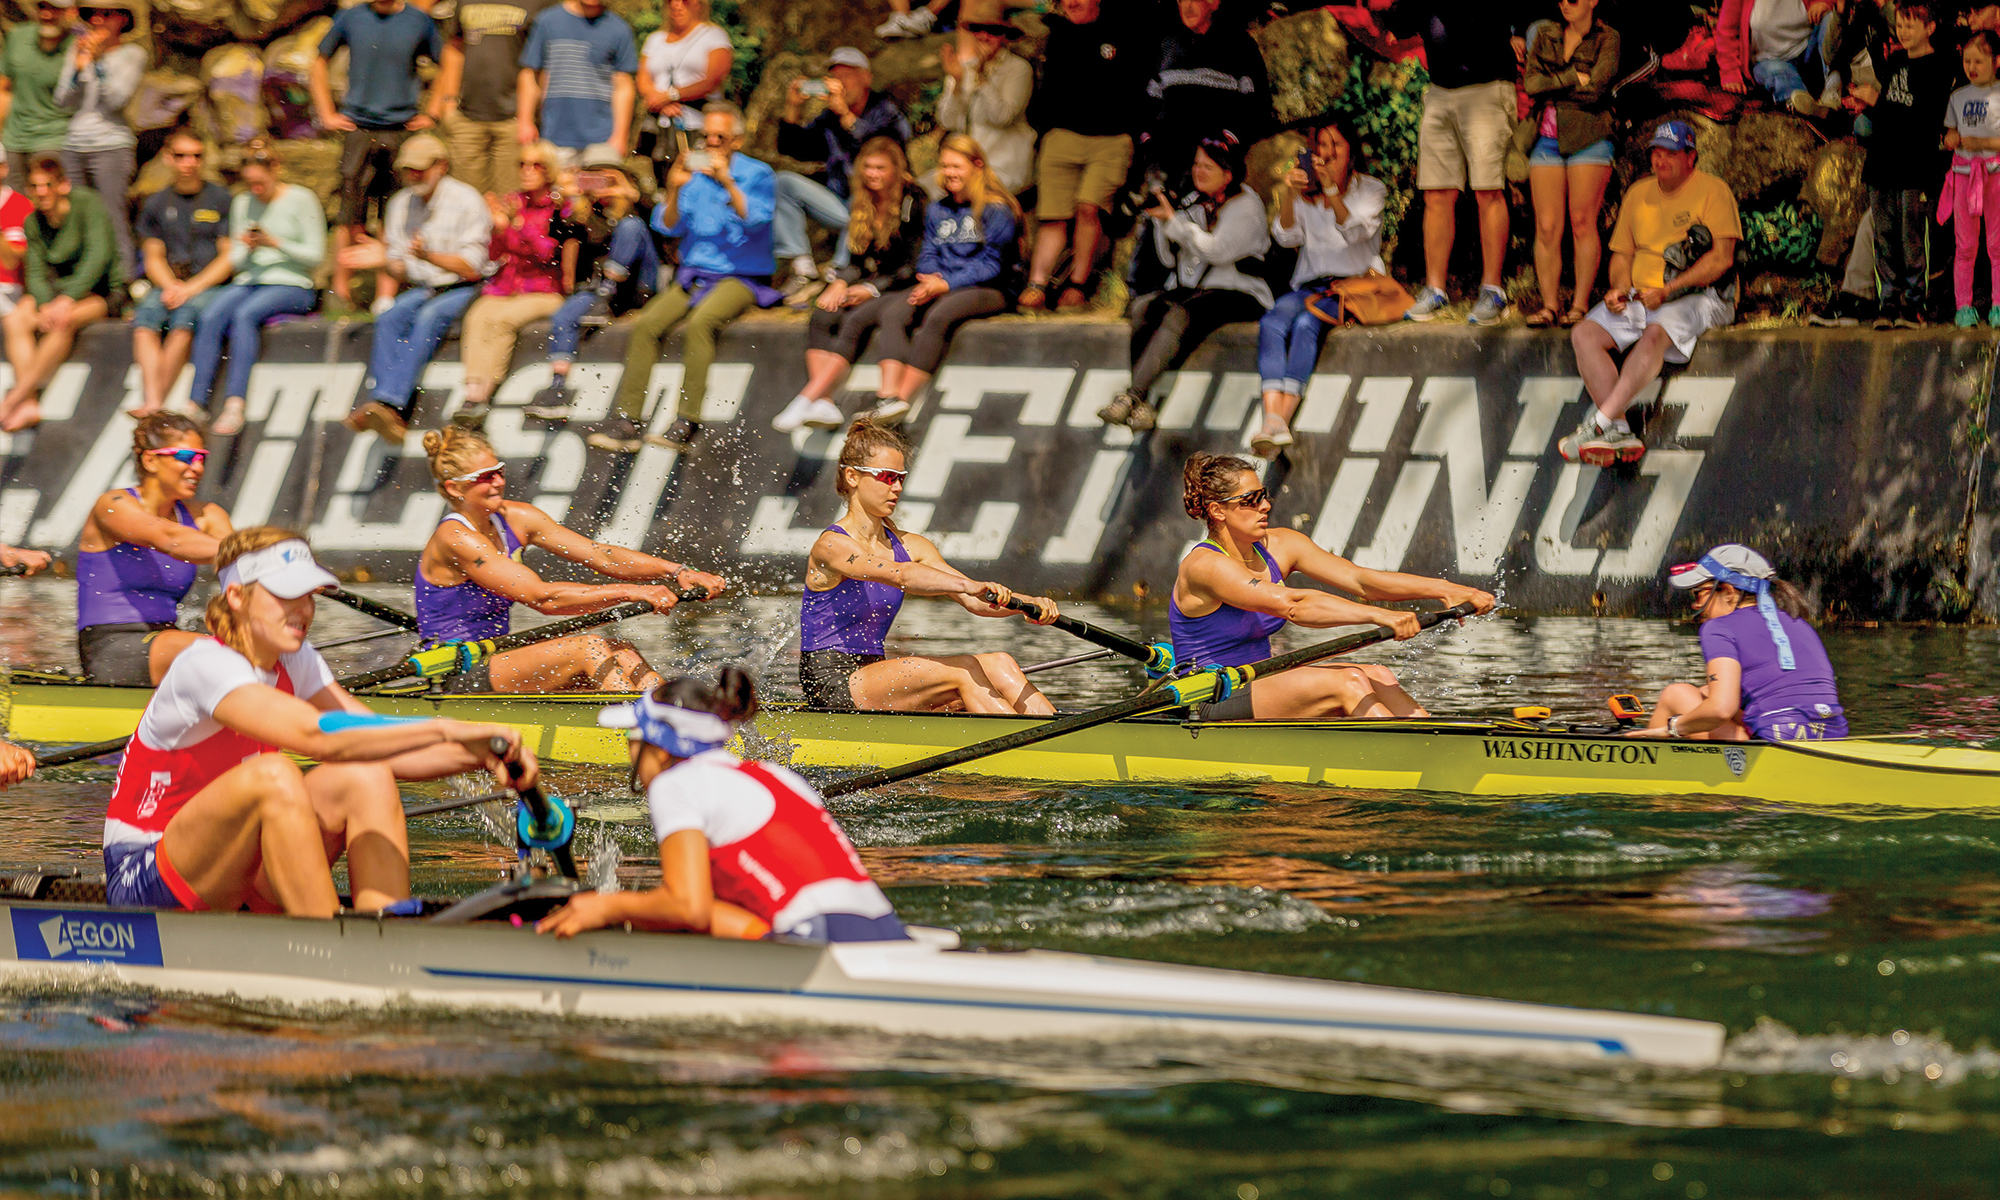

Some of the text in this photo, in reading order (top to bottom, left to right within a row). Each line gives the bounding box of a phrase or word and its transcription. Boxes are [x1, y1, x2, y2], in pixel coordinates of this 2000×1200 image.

[1483, 740, 1660, 764] WASHINGTON
[1670, 745, 1722, 755] EMPACHER
[53, 918, 135, 950] AEGON
